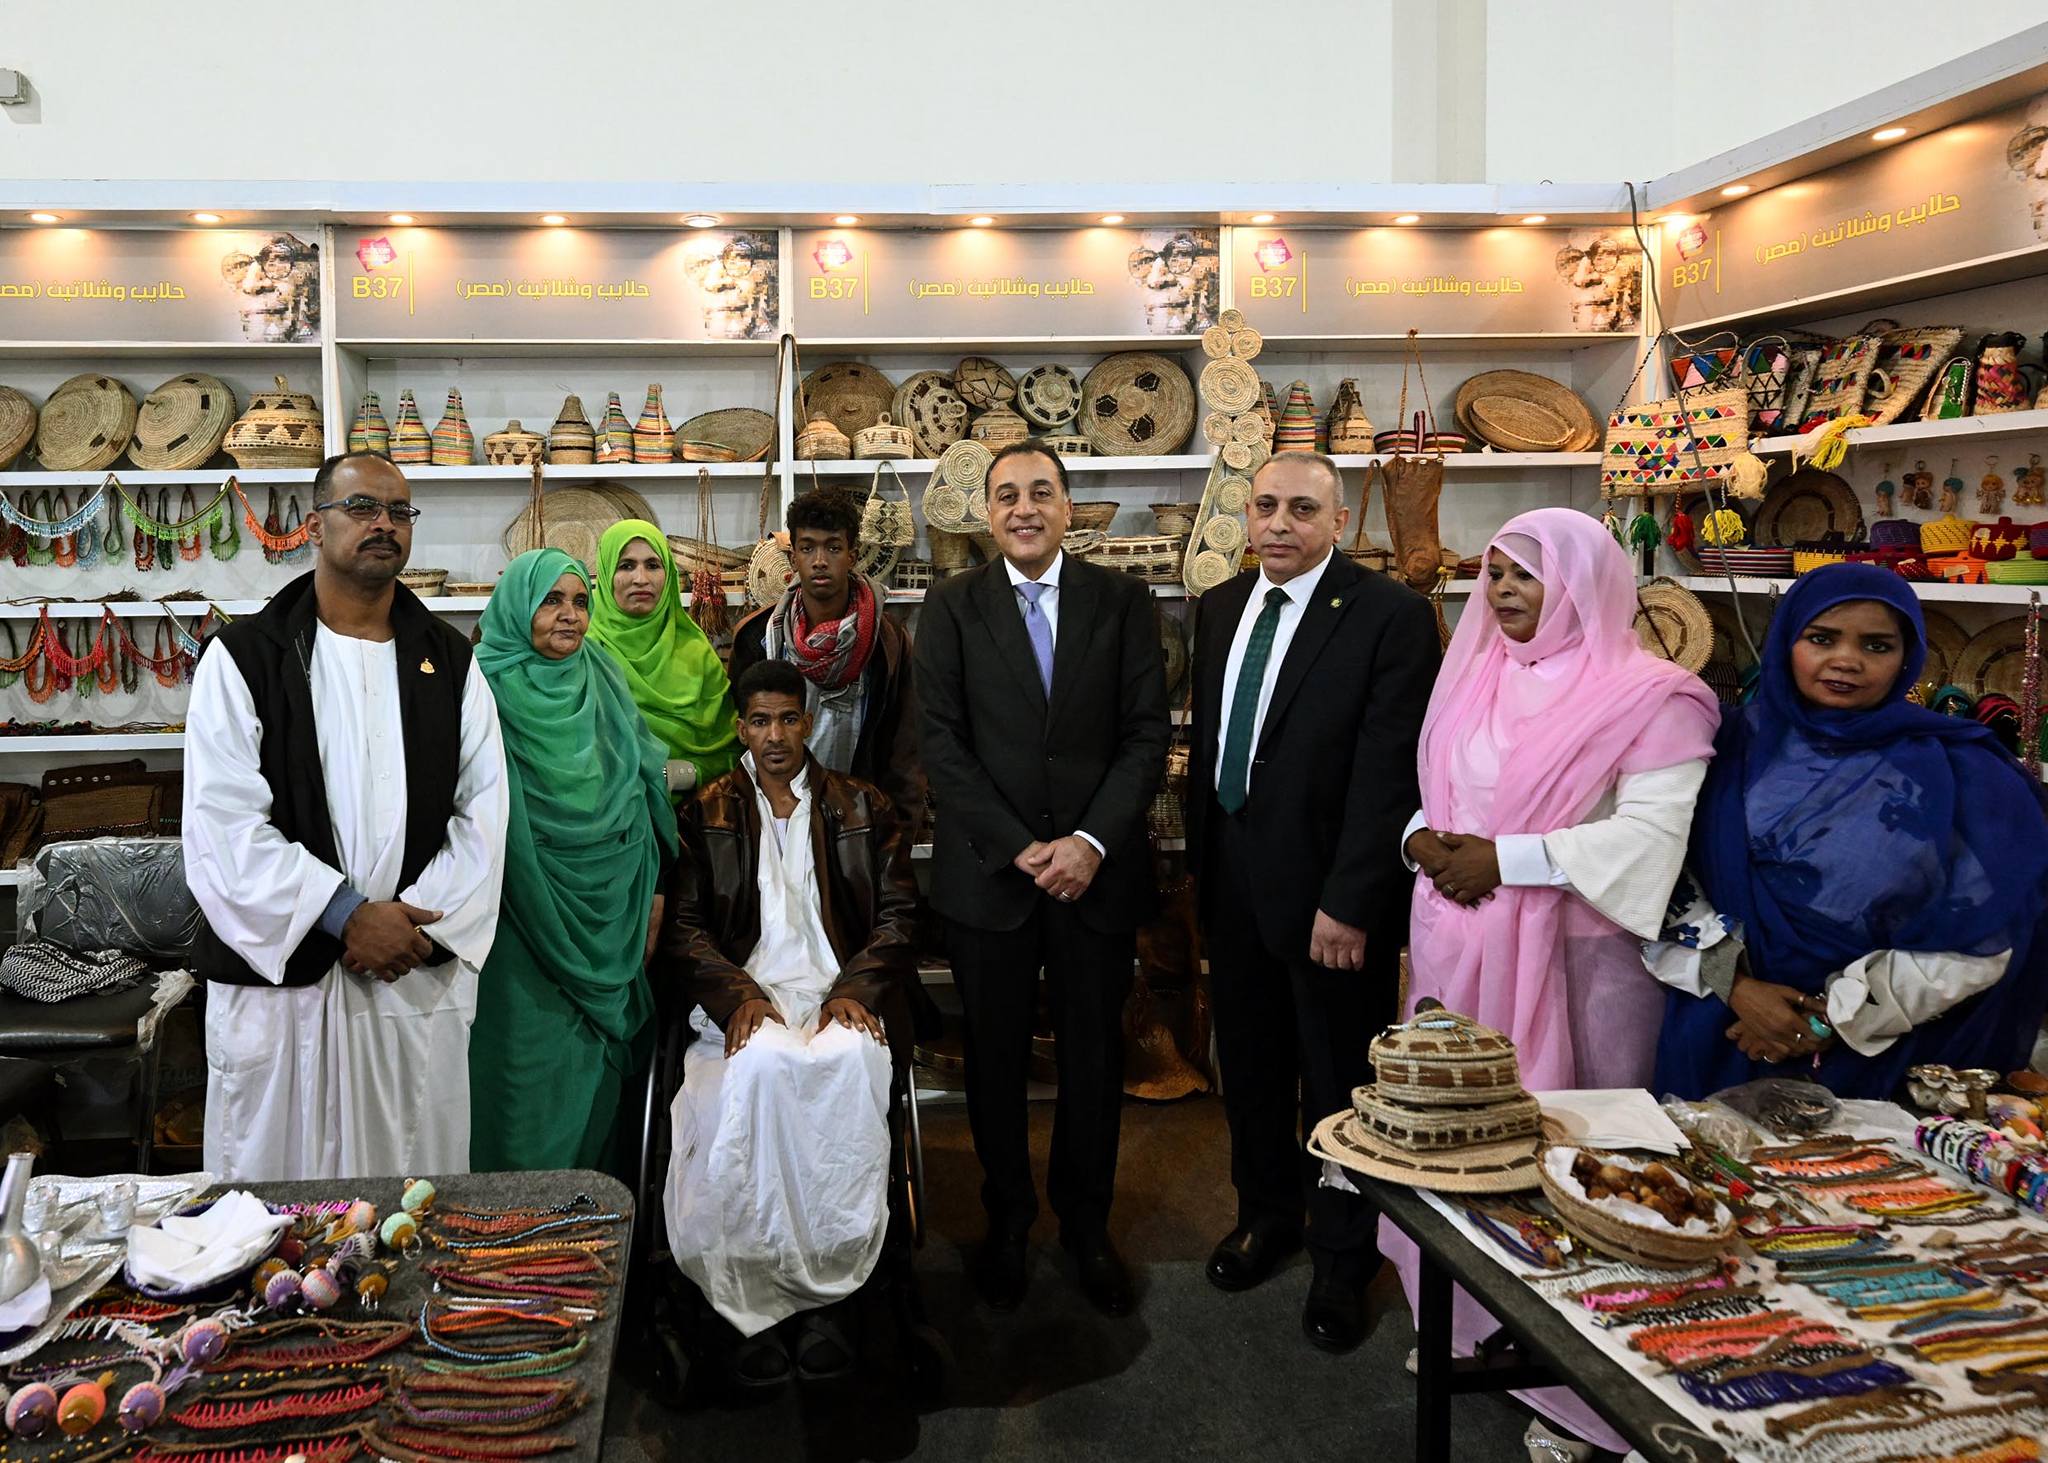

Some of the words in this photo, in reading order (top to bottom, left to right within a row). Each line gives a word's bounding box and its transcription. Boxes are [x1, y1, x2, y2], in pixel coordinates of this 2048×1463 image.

[1896, 192, 1960, 228] حلايب
[1811, 211, 1891, 249] وشلاتين
[1755, 233, 1808, 265] (مصر)
[1672, 258, 1712, 288] B37
[0, 280, 42, 298] (مص
[47, 280, 126, 302] وشلاتين
[130, 281, 186, 302] حلايب
[352, 276, 403, 298] B37
[456, 279, 512, 300] (مصر)
[516, 278, 592, 300] وشلاتين
[597, 279, 650, 300] حلايب
[809, 277, 858, 299] B37
[908, 279, 963, 299] (مصر)
[967, 276, 1040, 299] وشلاتين
[1043, 278, 1095, 299] حلايب
[1250, 276, 1298, 298] B37
[1345, 277, 1397, 298] (مصر)
[1401, 274, 1472, 298] وشلاتين
[1475, 276, 1523, 297] حلايب
